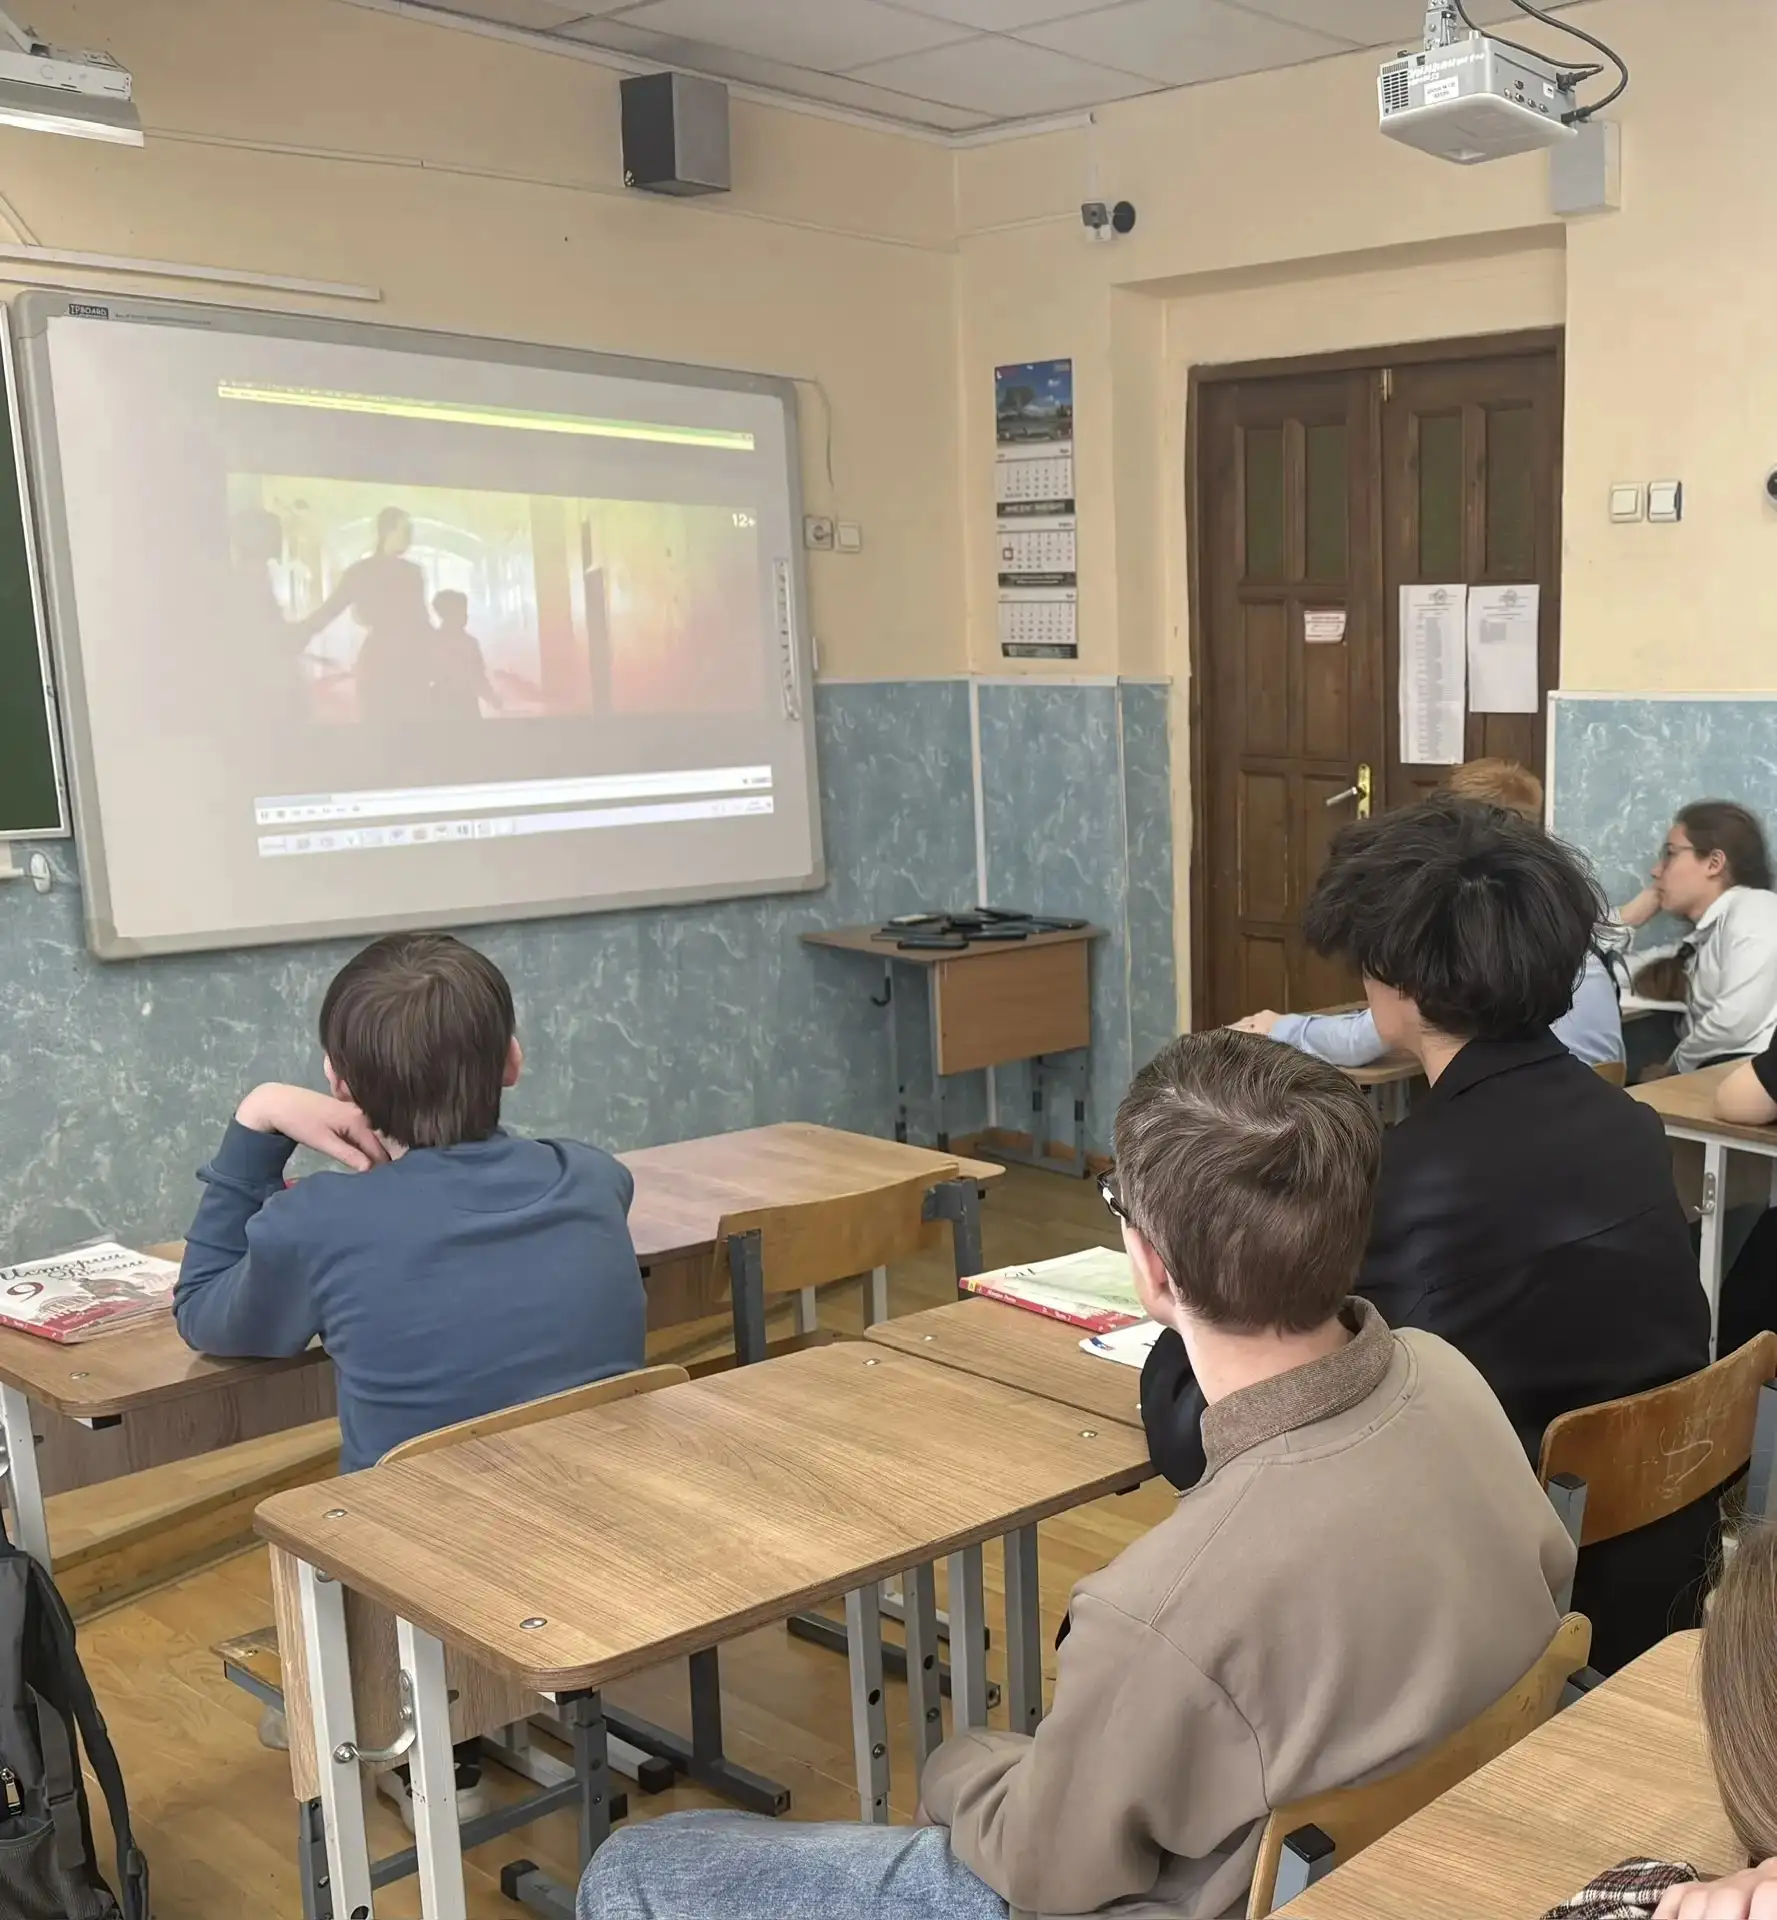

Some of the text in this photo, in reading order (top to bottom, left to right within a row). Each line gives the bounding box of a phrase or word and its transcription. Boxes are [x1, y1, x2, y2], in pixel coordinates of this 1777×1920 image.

[70, 305, 107, 316] IPBOARD
[732, 513, 756, 528] 12+
[6, 1281, 44, 1302] 9
